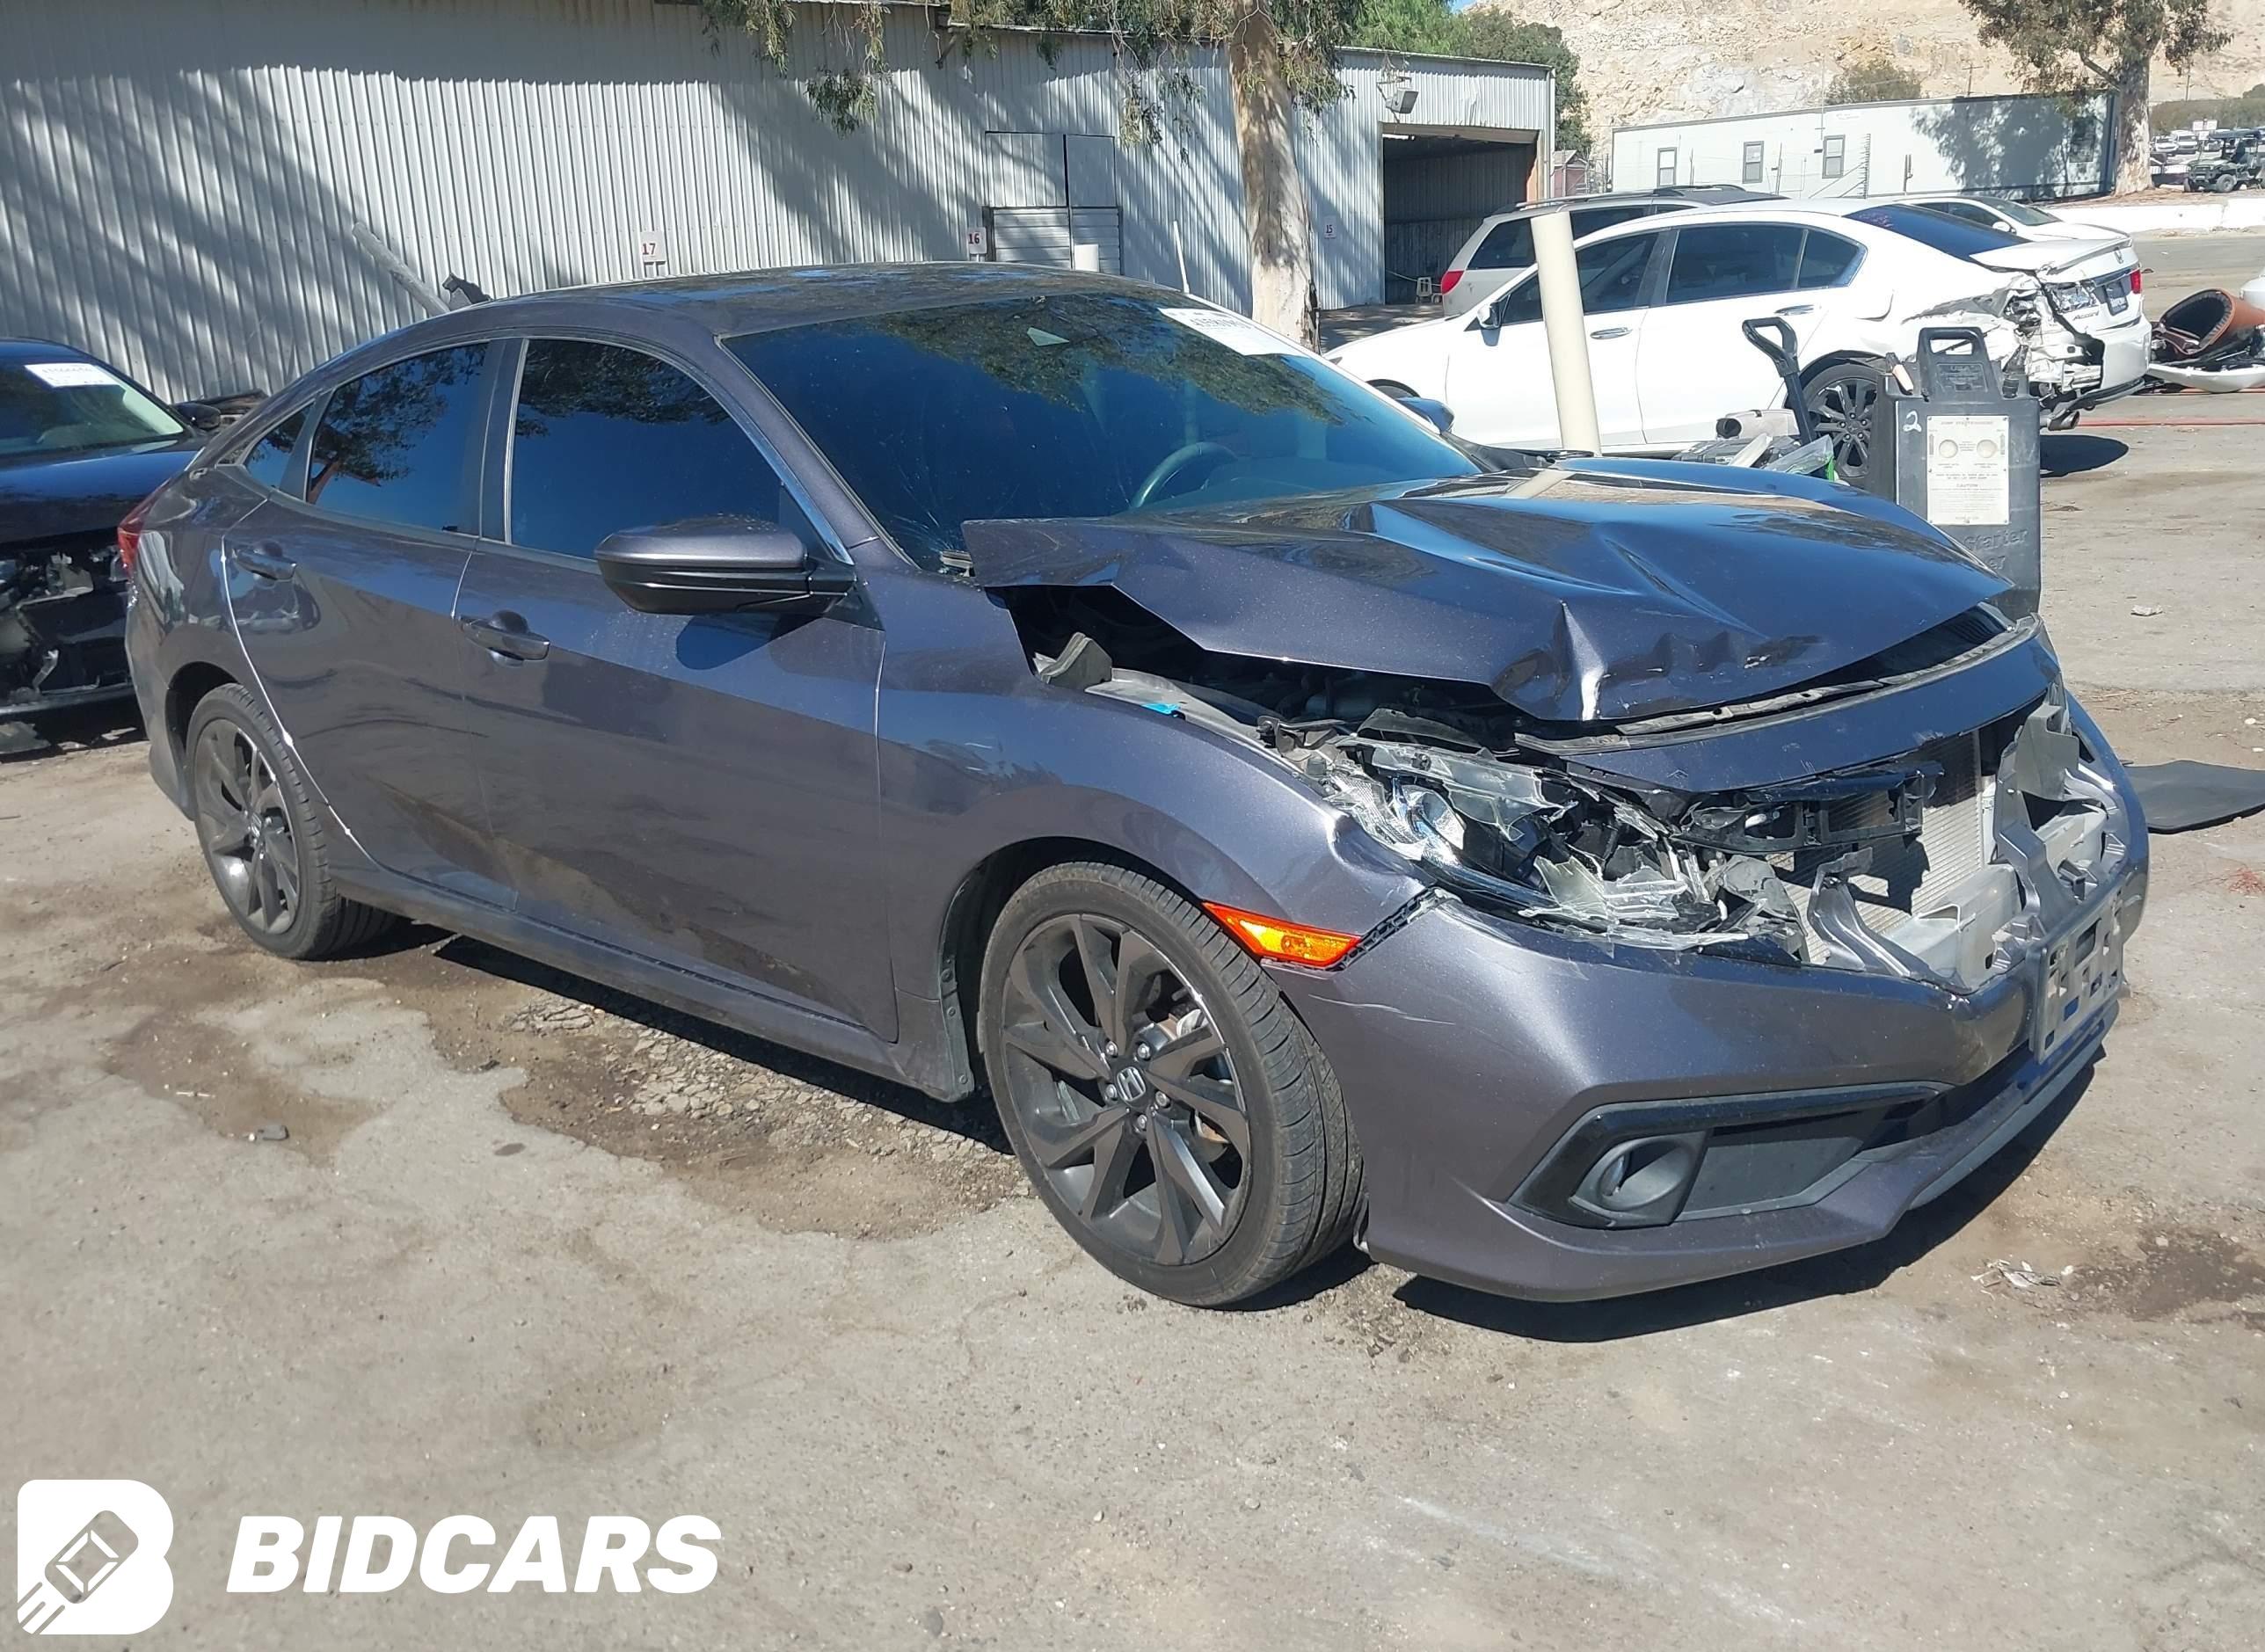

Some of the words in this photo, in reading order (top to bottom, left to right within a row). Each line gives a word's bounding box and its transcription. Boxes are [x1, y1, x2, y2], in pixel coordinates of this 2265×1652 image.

[1326, 224, 1333, 234] 15
[968, 232, 980, 244] 16
[642, 243, 656, 255] 17
[1903, 411, 1922, 433] 2
